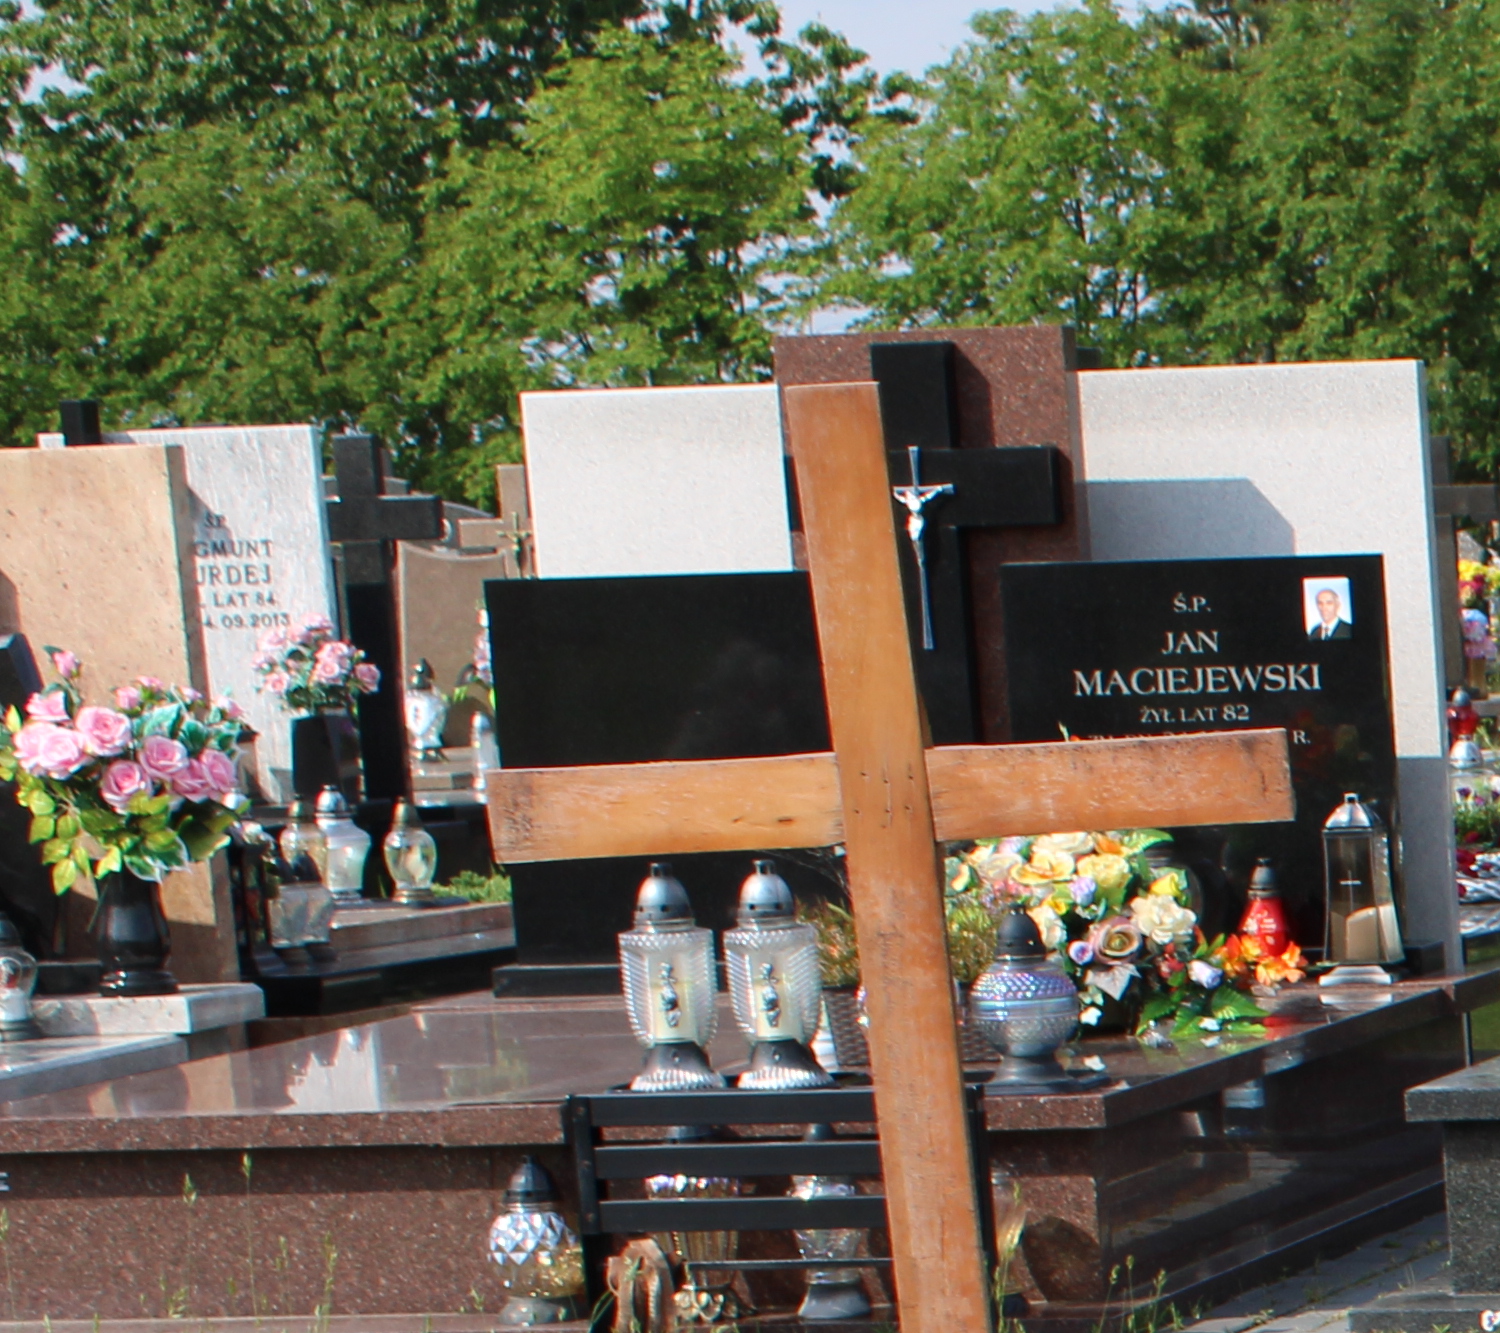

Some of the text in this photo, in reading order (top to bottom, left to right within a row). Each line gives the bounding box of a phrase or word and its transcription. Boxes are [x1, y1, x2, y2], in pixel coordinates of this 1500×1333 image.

[1173, 592, 1212, 613] Ś.P.
[1162, 630, 1219, 655] JAN
[1073, 663, 1322, 697] MACIEJEWSKI
[1140, 703, 1250, 723] ŻYŁ LAT 82
